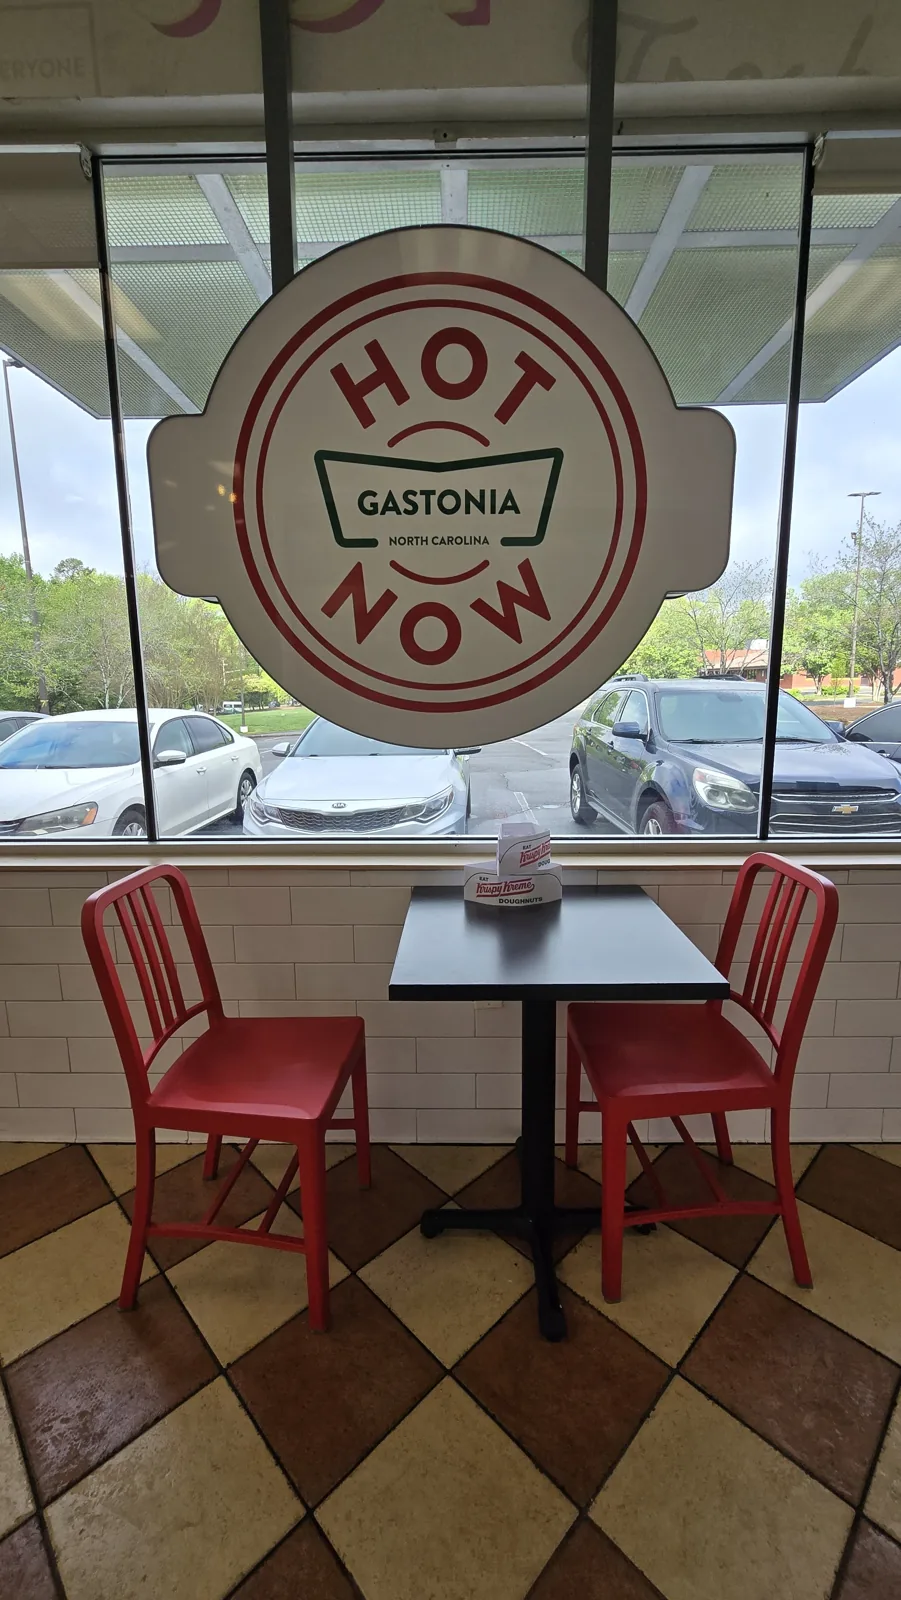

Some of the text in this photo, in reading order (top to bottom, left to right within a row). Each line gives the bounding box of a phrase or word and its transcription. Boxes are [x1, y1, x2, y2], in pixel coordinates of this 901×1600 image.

[329, 326, 557, 430] HOT
[357, 488, 521, 516] GASTONIA
[389, 535, 490, 546] NORTH CAROLINA
[320, 557, 552, 666] NOW
[520, 848, 541, 867] Krispy
[476, 877, 535, 898] Krispy Kreme
